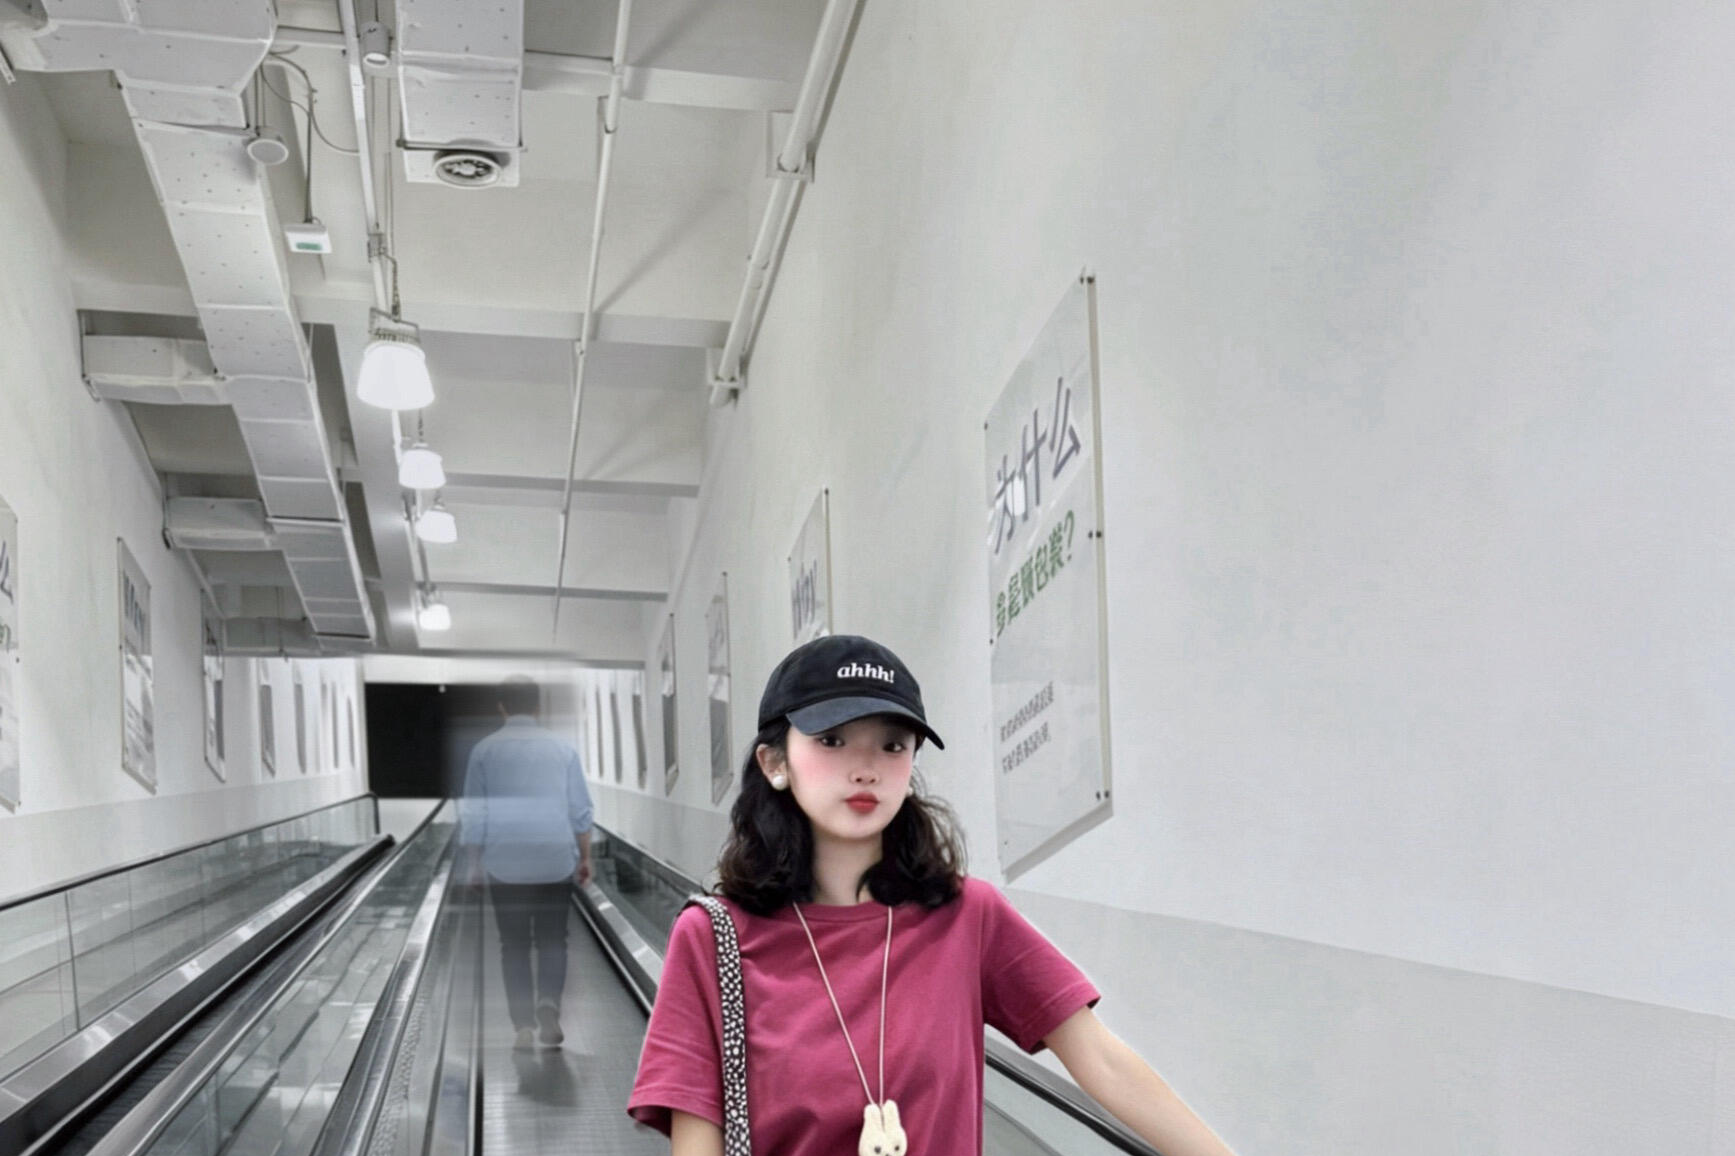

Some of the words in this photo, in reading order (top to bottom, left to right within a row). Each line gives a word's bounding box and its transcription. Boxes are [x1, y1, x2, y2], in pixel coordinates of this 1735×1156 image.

[995, 376, 1081, 554] 为什么
[837, 662, 895, 684] ahhh!
